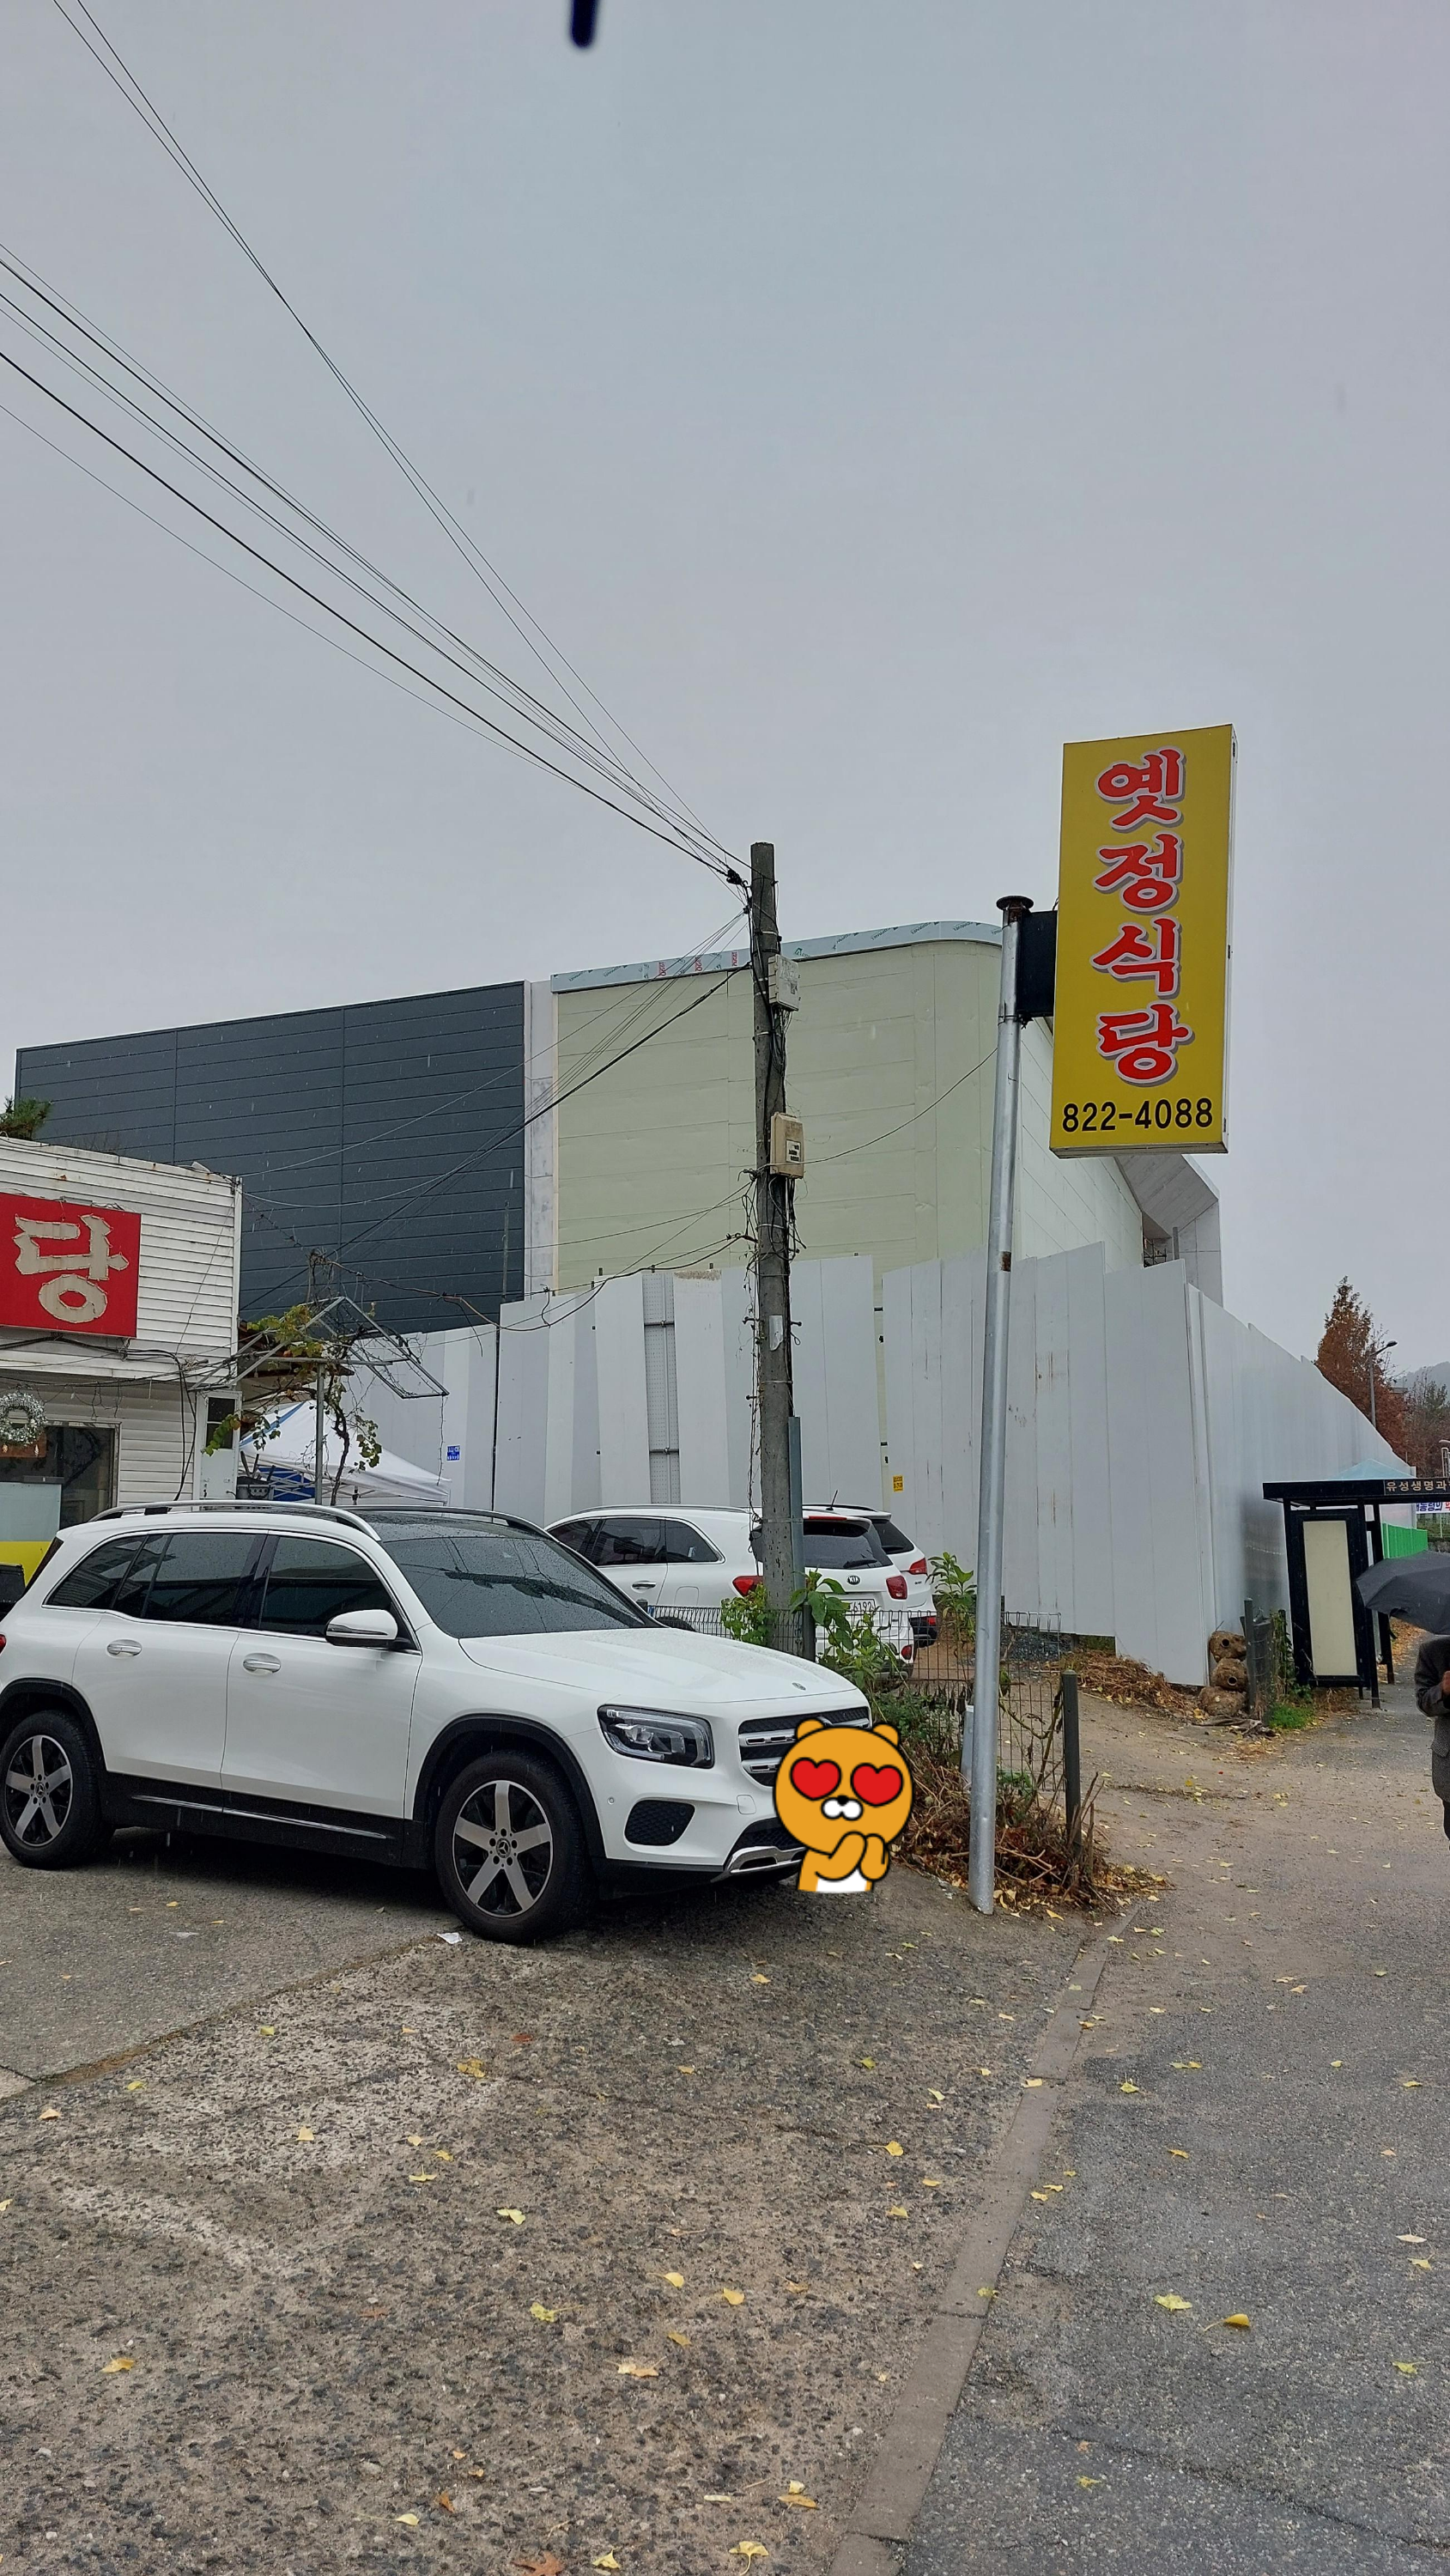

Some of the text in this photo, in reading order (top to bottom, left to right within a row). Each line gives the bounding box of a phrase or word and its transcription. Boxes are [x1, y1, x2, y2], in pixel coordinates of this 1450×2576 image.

[1091, 746, 1195, 1084] 옛정식당
[1062, 1098, 1213, 1133] 822-4088
[13, 1213, 130, 1323] 당
[1386, 1479, 1450, 1492] 유성생명과
